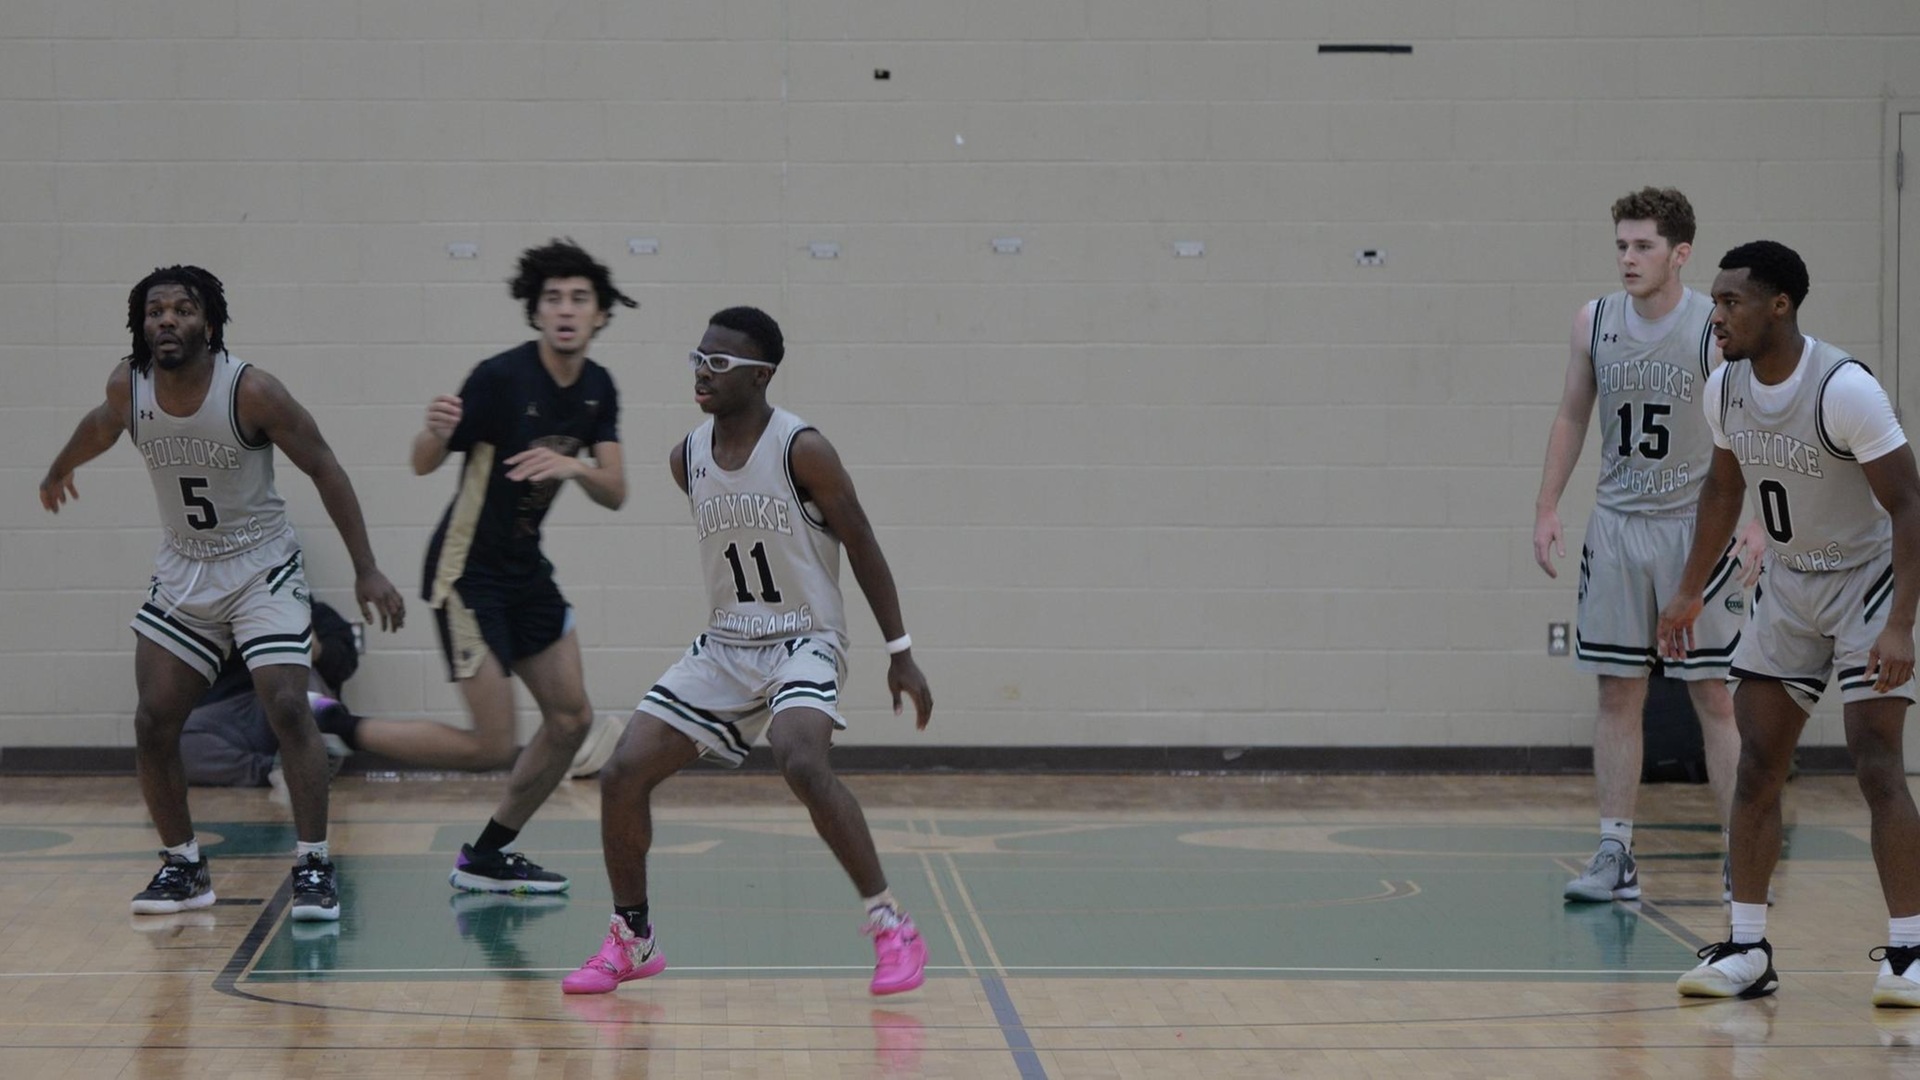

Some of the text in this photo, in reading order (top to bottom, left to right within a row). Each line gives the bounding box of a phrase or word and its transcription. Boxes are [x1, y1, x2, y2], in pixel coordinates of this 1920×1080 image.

[1599, 360, 1694, 403] HOLYOKE
[140, 436, 241, 470] HOLYOKE
[1616, 401, 1672, 461] 15
[178, 475, 219, 531] 5
[1758, 477, 1794, 546] 0
[723, 539, 783, 604] 11
[714, 603, 813, 639] COUGARS
